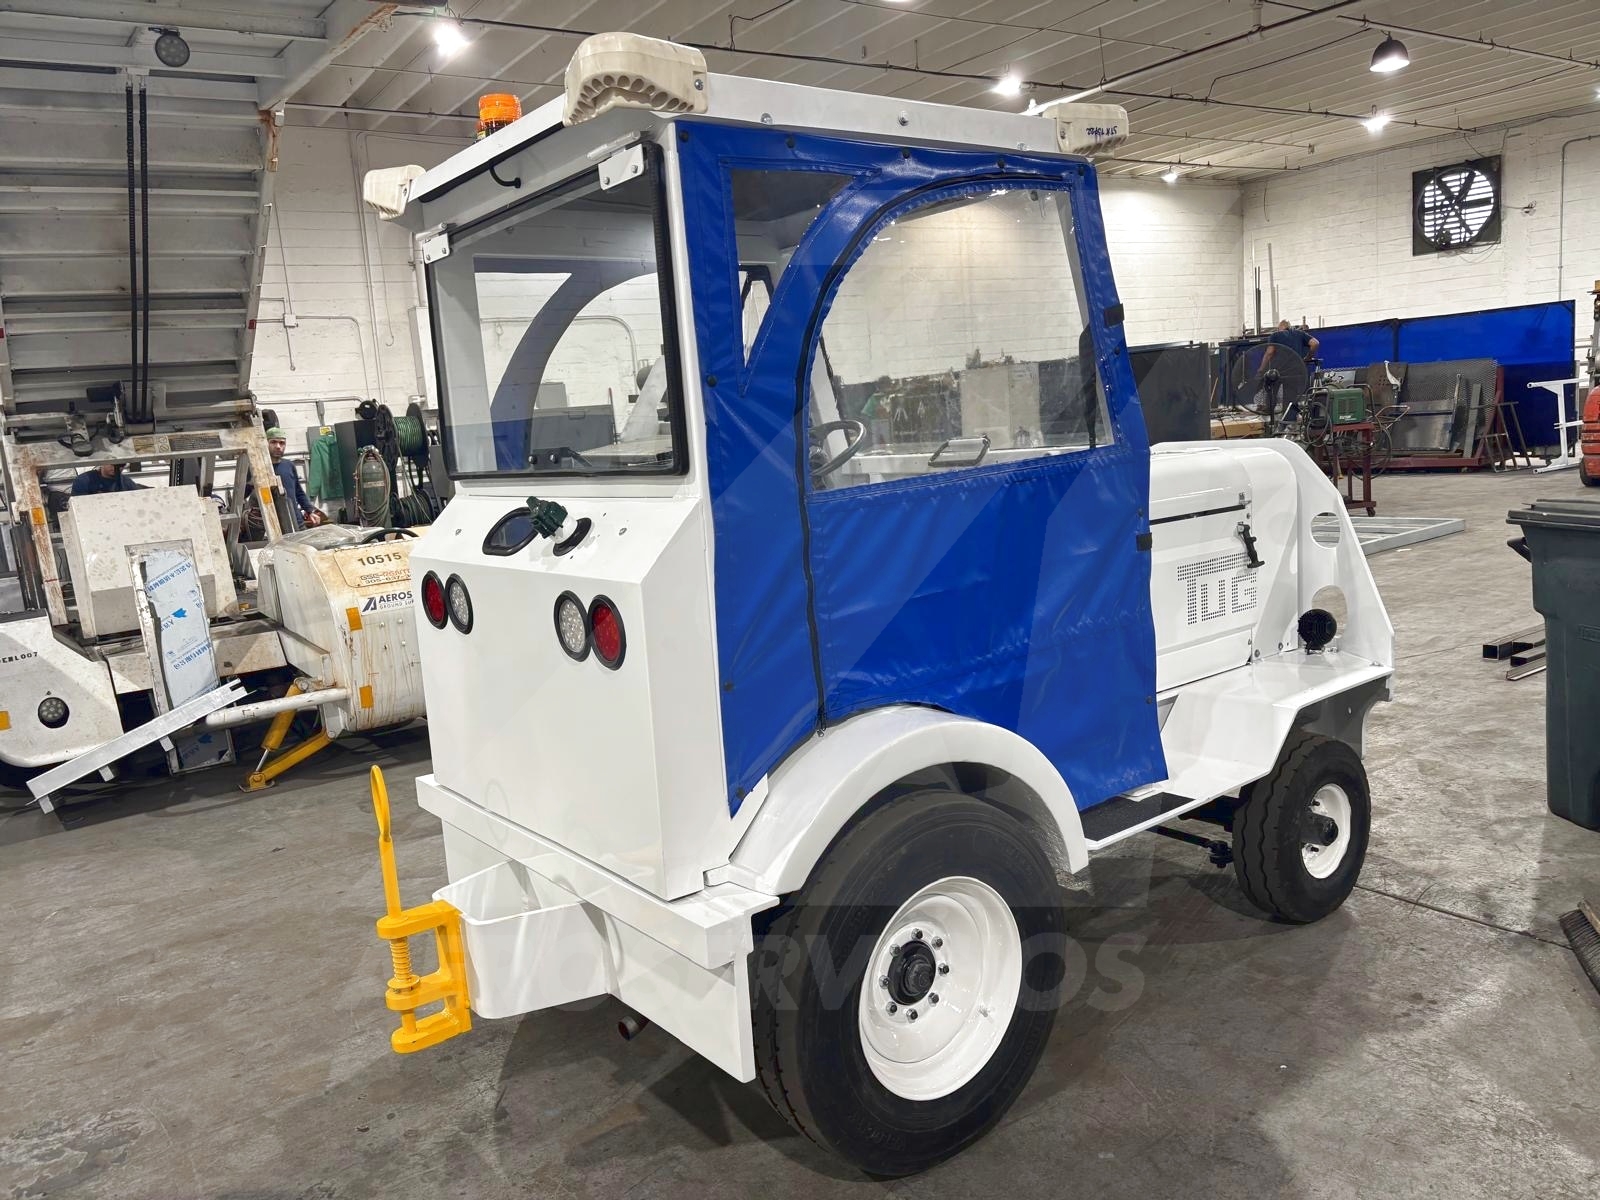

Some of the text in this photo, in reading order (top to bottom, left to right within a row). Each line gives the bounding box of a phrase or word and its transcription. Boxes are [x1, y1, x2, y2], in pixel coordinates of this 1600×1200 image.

[357, 552, 402, 566] 10515
[1177, 552, 1257, 625] TUG
[378, 591, 413, 603] AEROS
